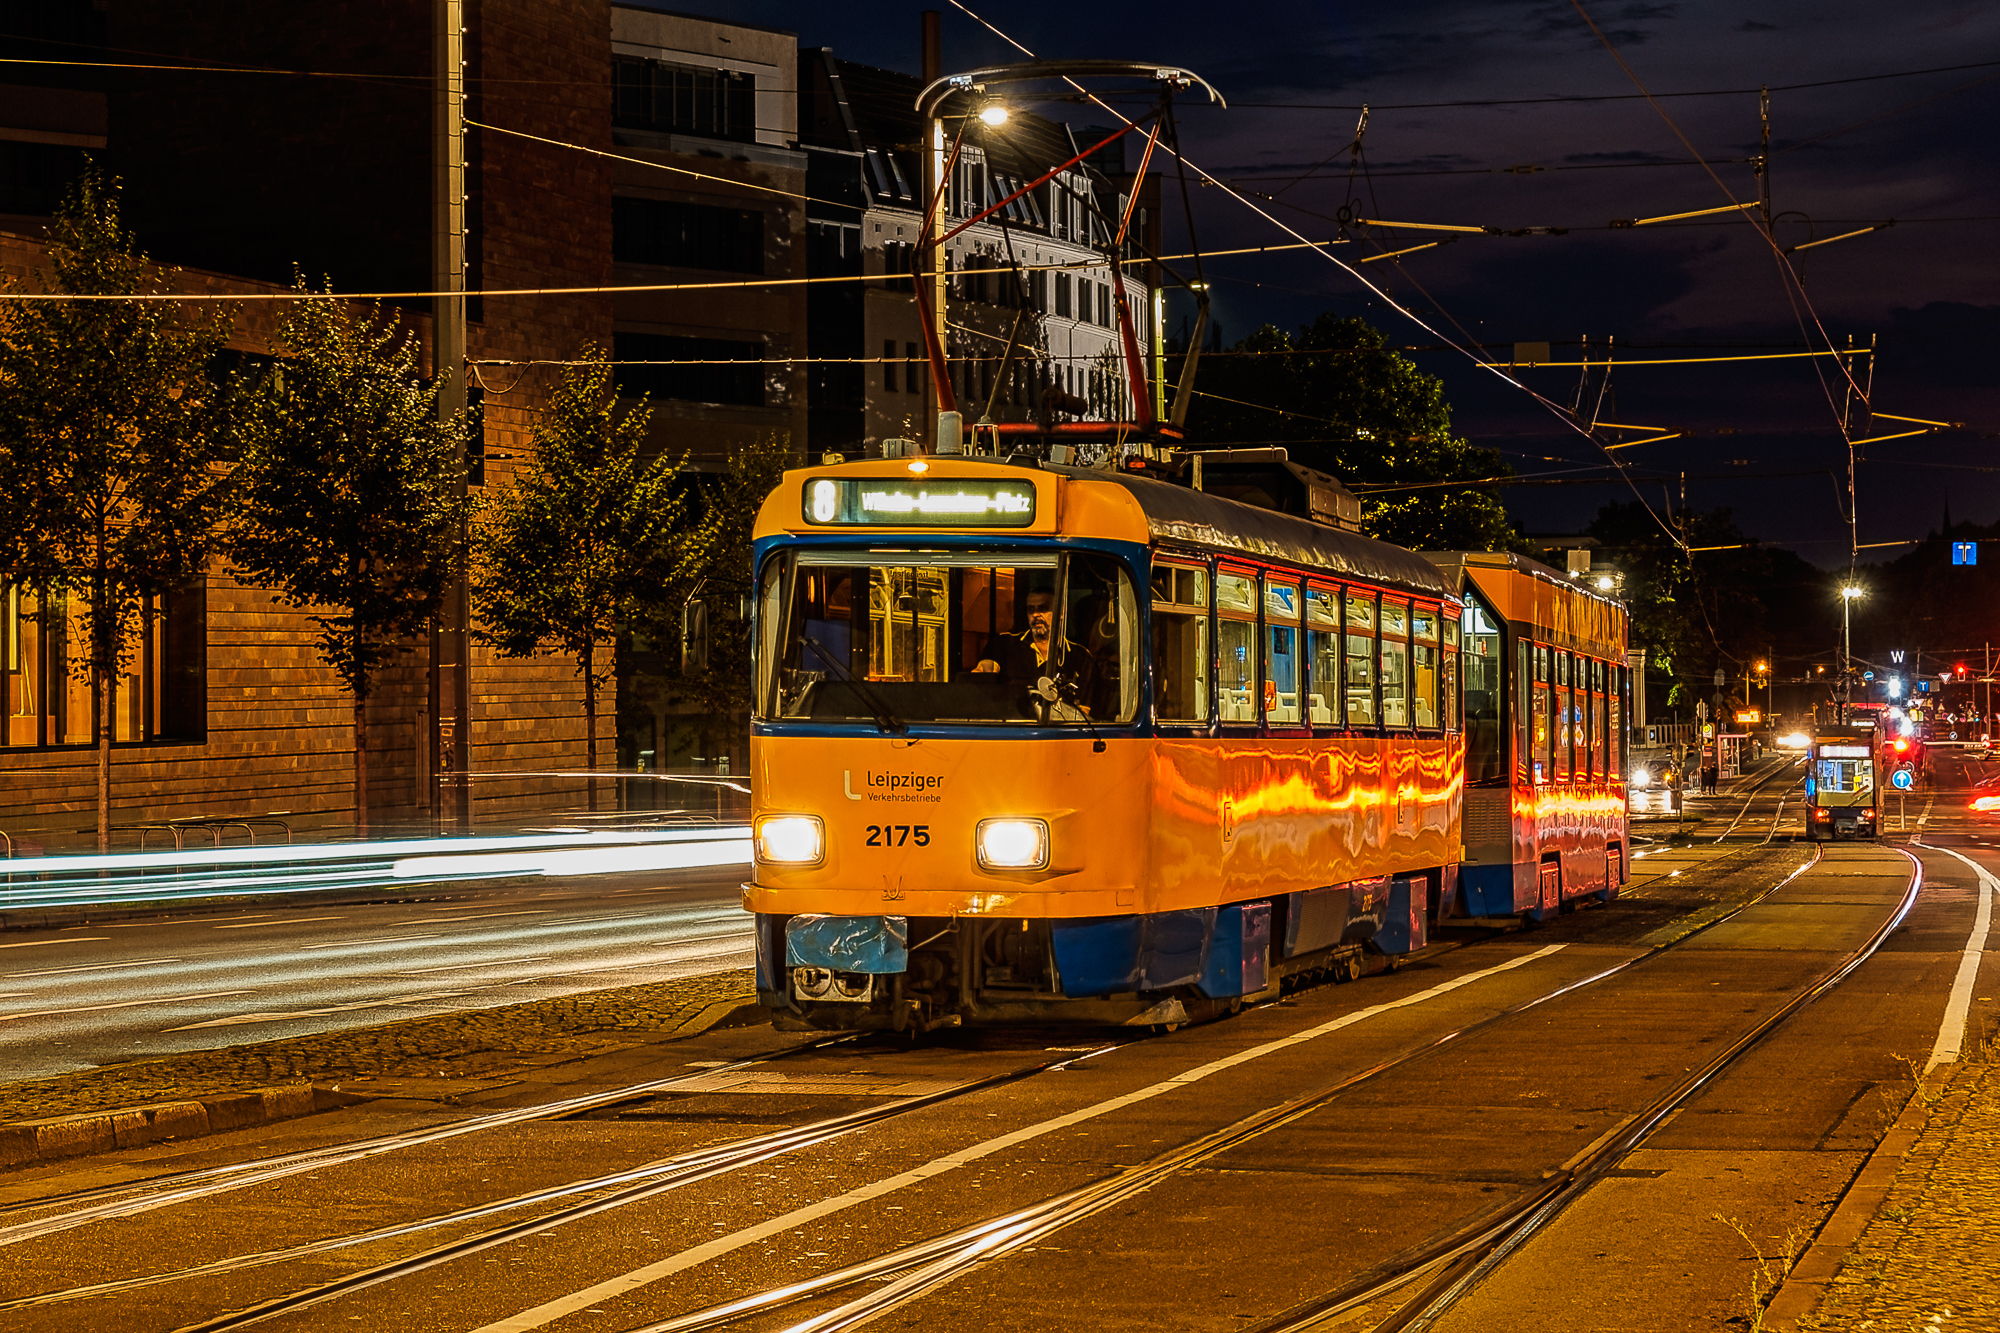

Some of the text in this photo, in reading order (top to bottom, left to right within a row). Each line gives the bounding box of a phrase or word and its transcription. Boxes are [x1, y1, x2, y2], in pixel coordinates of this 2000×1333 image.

[1890, 650, 1905, 663] W
[867, 770, 944, 792] Leipziger
[867, 792, 941, 803] Verkehrsbetriebe
[865, 825, 931, 847] 2175
